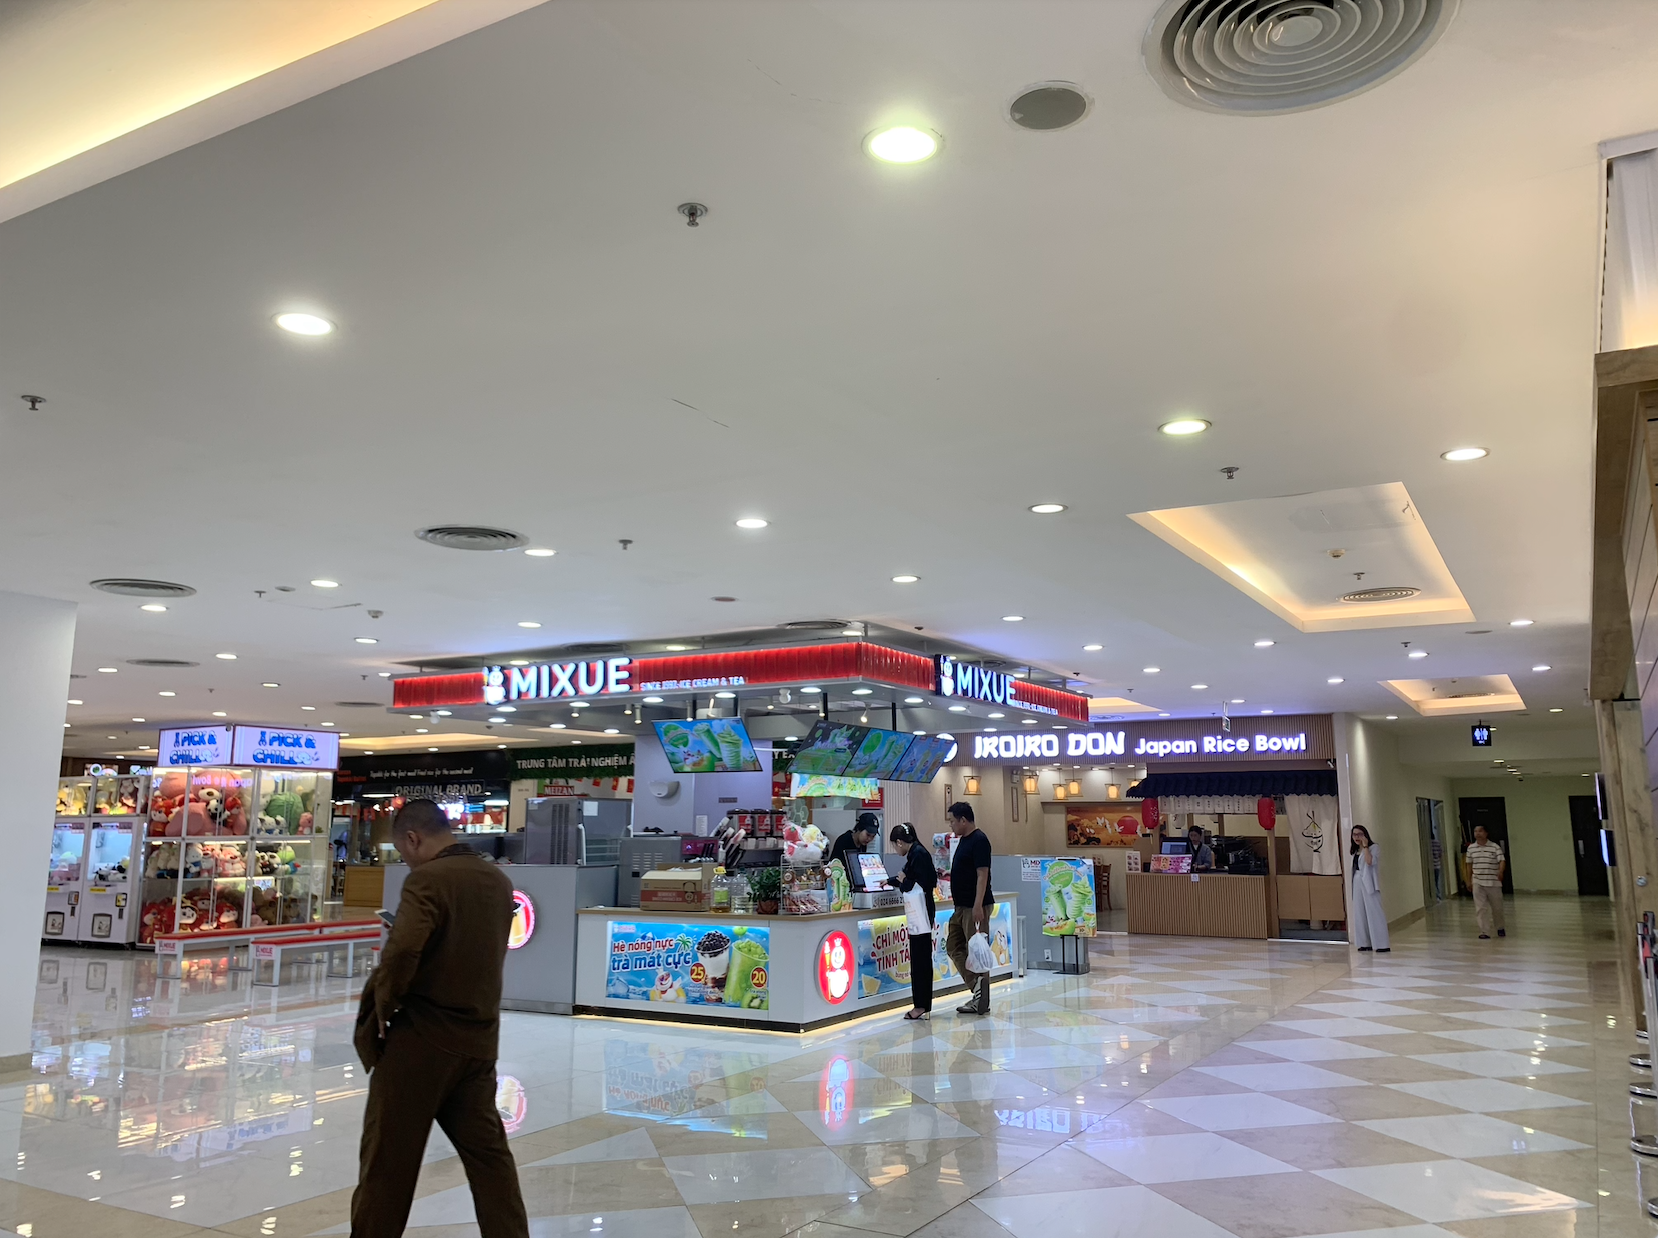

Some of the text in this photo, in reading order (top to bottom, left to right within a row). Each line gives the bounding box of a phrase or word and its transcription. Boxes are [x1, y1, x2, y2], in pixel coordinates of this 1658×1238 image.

[509, 657, 632, 700] MIXUE
[640, 682, 661, 691] SINCE
[692, 678, 719, 688] CREAM
[720, 677, 727, 686] &
[729, 676, 745, 685] TEA
[957, 662, 1016, 706] MIXUE
[181, 730, 217, 746] PICK &
[269, 732, 316, 749] PICK &
[1067, 731, 1125, 756] DON
[1134, 738, 1197, 757] Japan
[1203, 735, 1250, 753] Rice
[1255, 733, 1306, 751] Bowl
[516, 759, 545, 769] TRUNG
[546, 756, 566, 768] TÂM
[591, 754, 626, 769] NGHIỆM
[395, 784, 482, 797] ORIGINAL BRAND
[544, 786, 574, 796] MEIZAN
[613, 938, 674, 954] Hè nóng nực
[876, 927, 891, 950] CHỈ
[612, 950, 693, 971] trà mát cực
[876, 951, 898, 972] TỈNH
[691, 966, 705, 980] 25
[752, 970, 766, 984] 20
